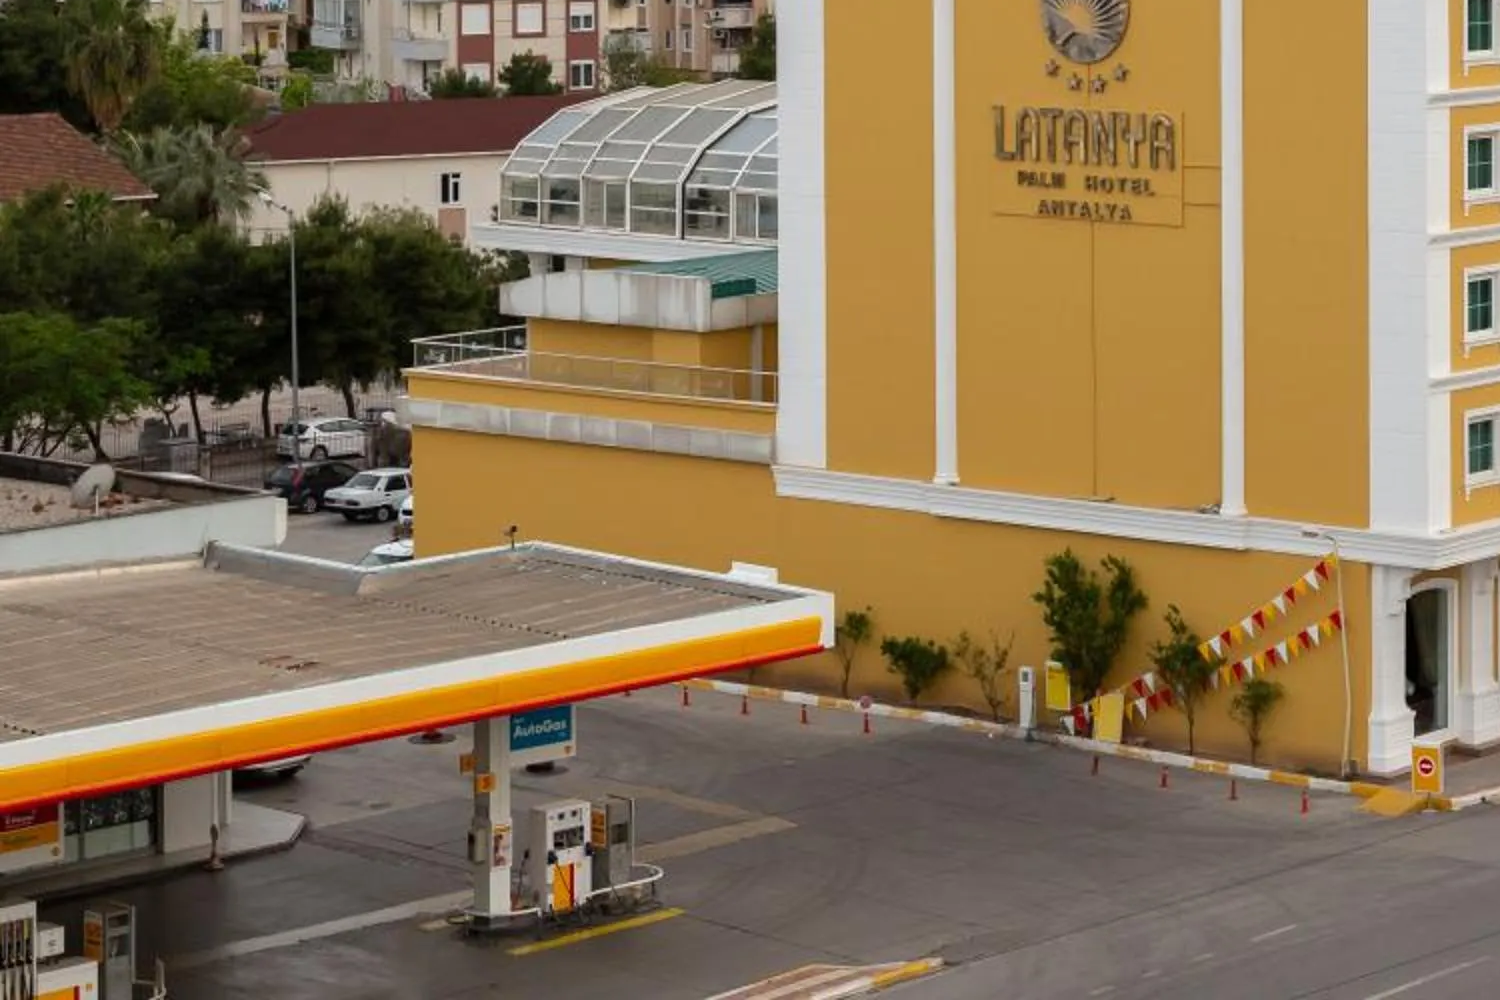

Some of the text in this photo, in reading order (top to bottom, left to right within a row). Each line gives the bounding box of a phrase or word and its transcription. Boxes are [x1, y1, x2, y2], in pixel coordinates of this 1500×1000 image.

[991, 104, 1176, 171] LATANYA
[1017, 169, 1156, 197] PALM HOTEL
[1037, 199, 1133, 221] ANTALYA
